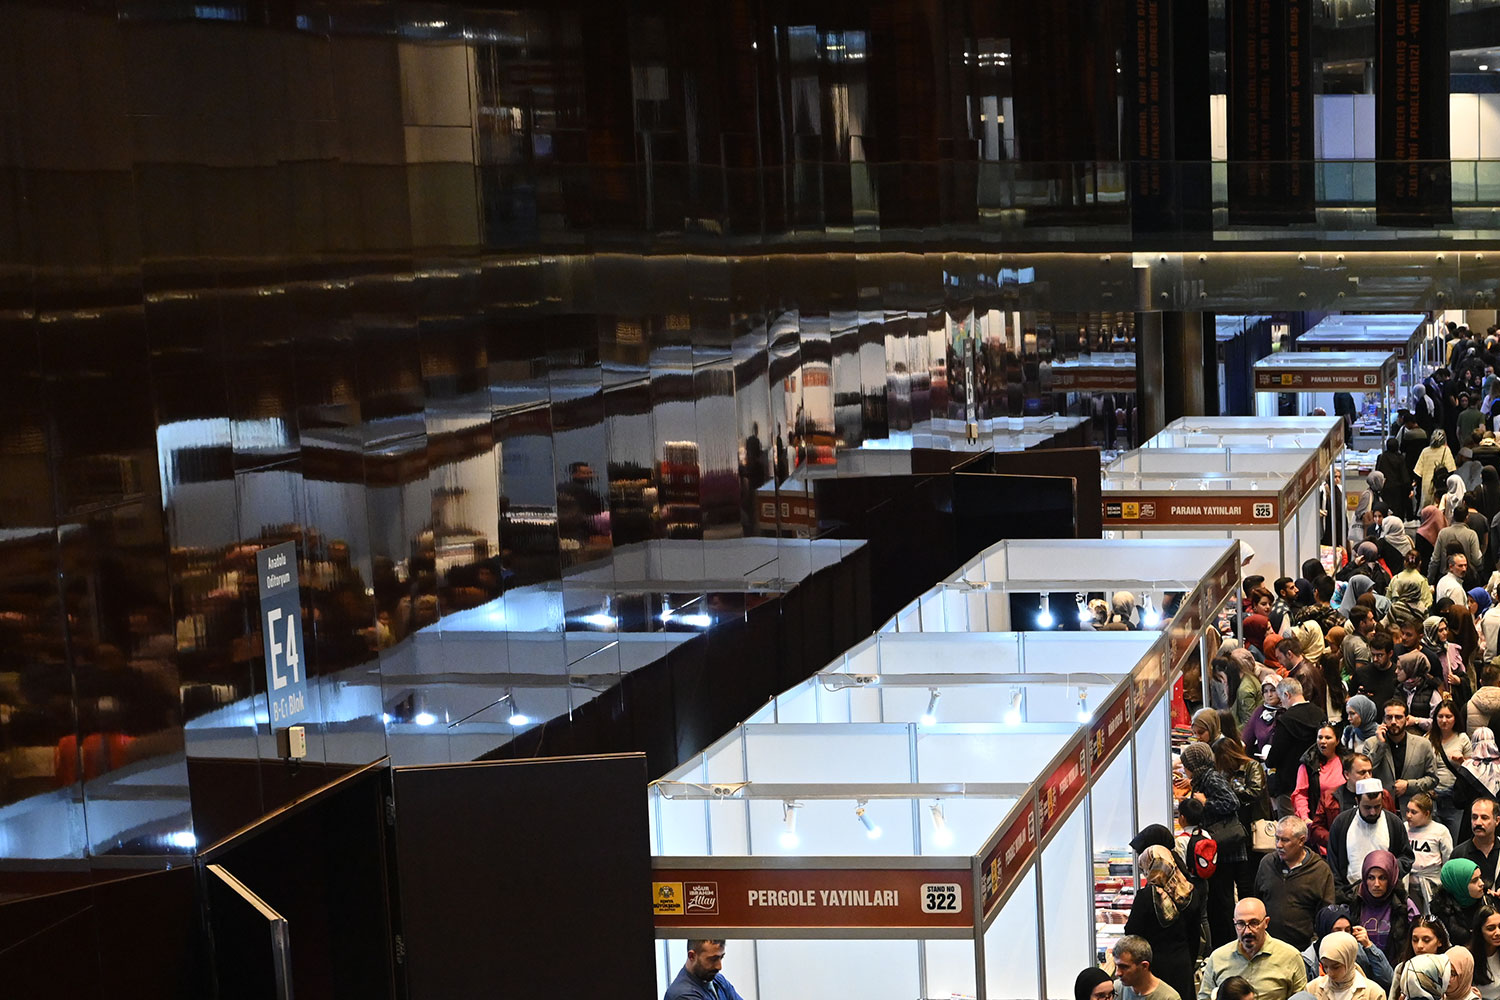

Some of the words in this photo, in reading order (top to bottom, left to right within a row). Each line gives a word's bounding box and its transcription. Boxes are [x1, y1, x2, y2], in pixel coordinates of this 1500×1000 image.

[1171, 506, 1202, 515] PARANA
[1203, 506, 1242, 515] YAYINLARI
[1255, 508, 1271, 517] 325
[268, 552, 287, 570] Anadolu
[266, 571, 291, 590] Oditoryum
[267, 607, 299, 691] E4
[288, 690, 304, 716] Blok
[748, 890, 816, 907] PERGOLE
[820, 890, 899, 907] YAYINLARI
[926, 893, 957, 910] 322
